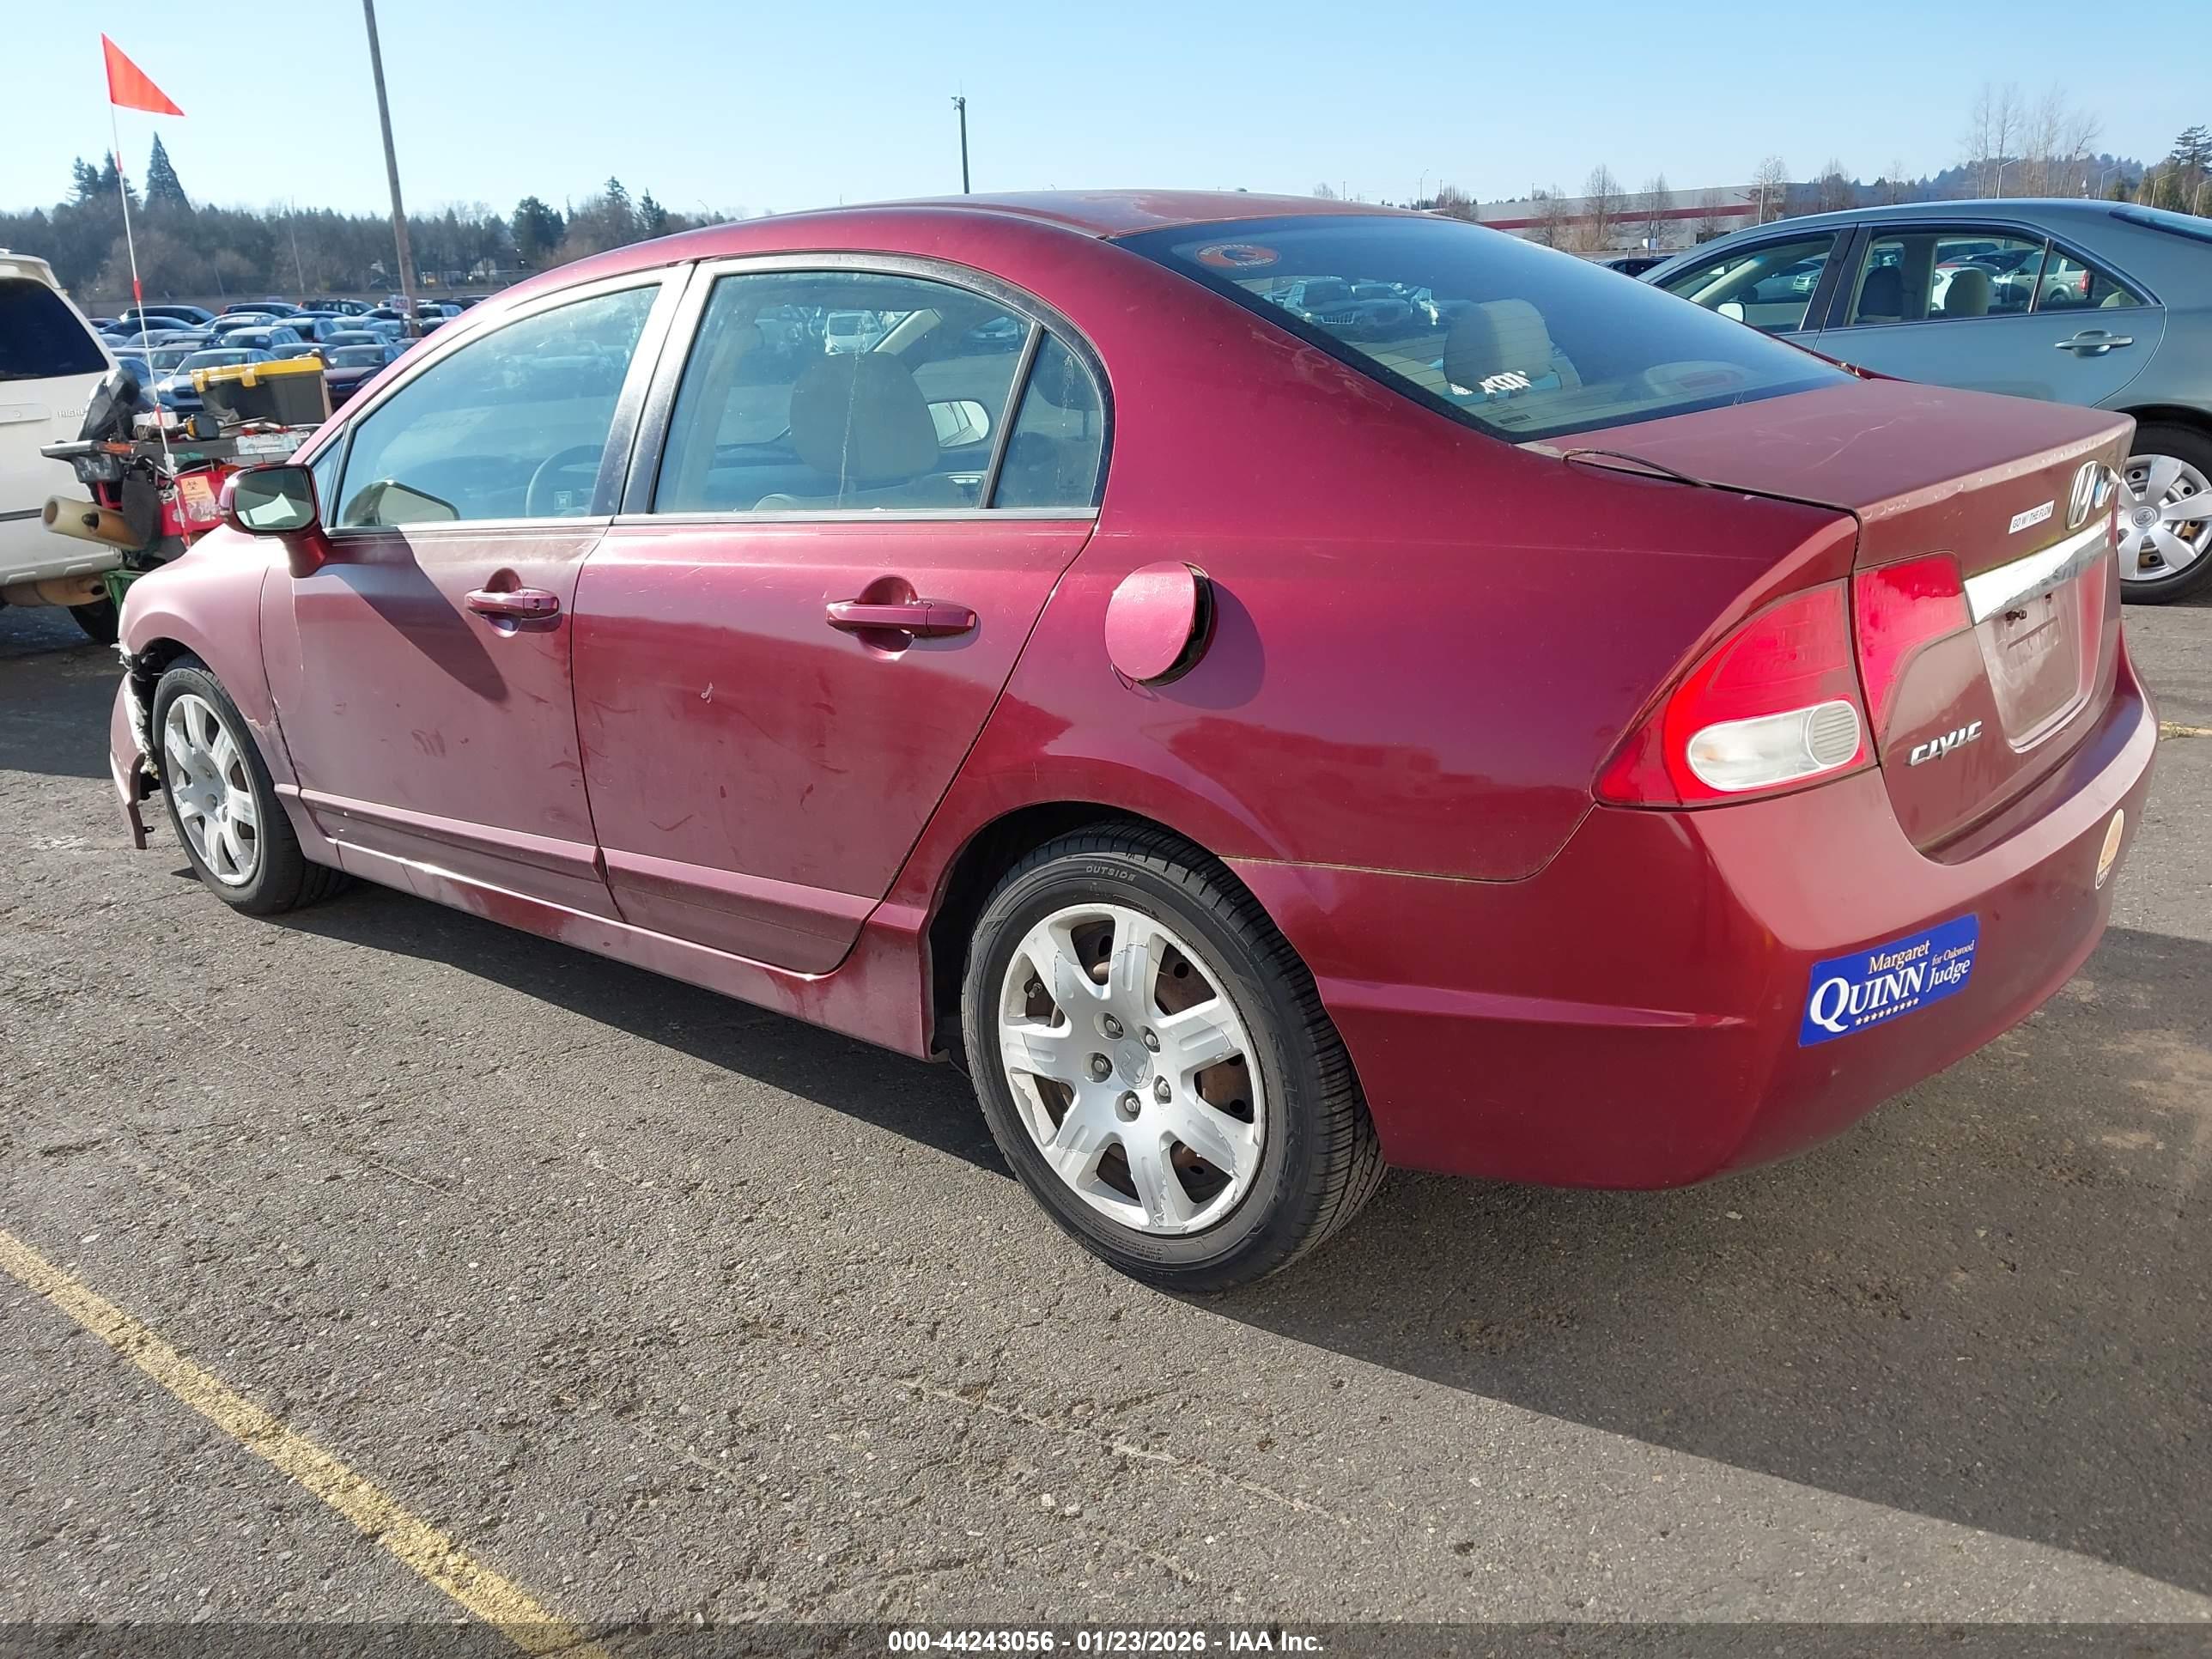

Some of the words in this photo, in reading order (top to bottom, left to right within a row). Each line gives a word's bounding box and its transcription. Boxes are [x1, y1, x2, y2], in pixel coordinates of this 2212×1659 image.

[1910, 720, 1982, 766] CIVIC
[1085, 865, 1137, 881] OUTSIDE
[1868, 939, 1930, 975] Margaret
[1931, 954, 1943, 966] for
[1943, 940, 1975, 960] Oakwood
[1926, 959, 1971, 993] Judge
[1809, 963, 1927, 1033] QUINN
